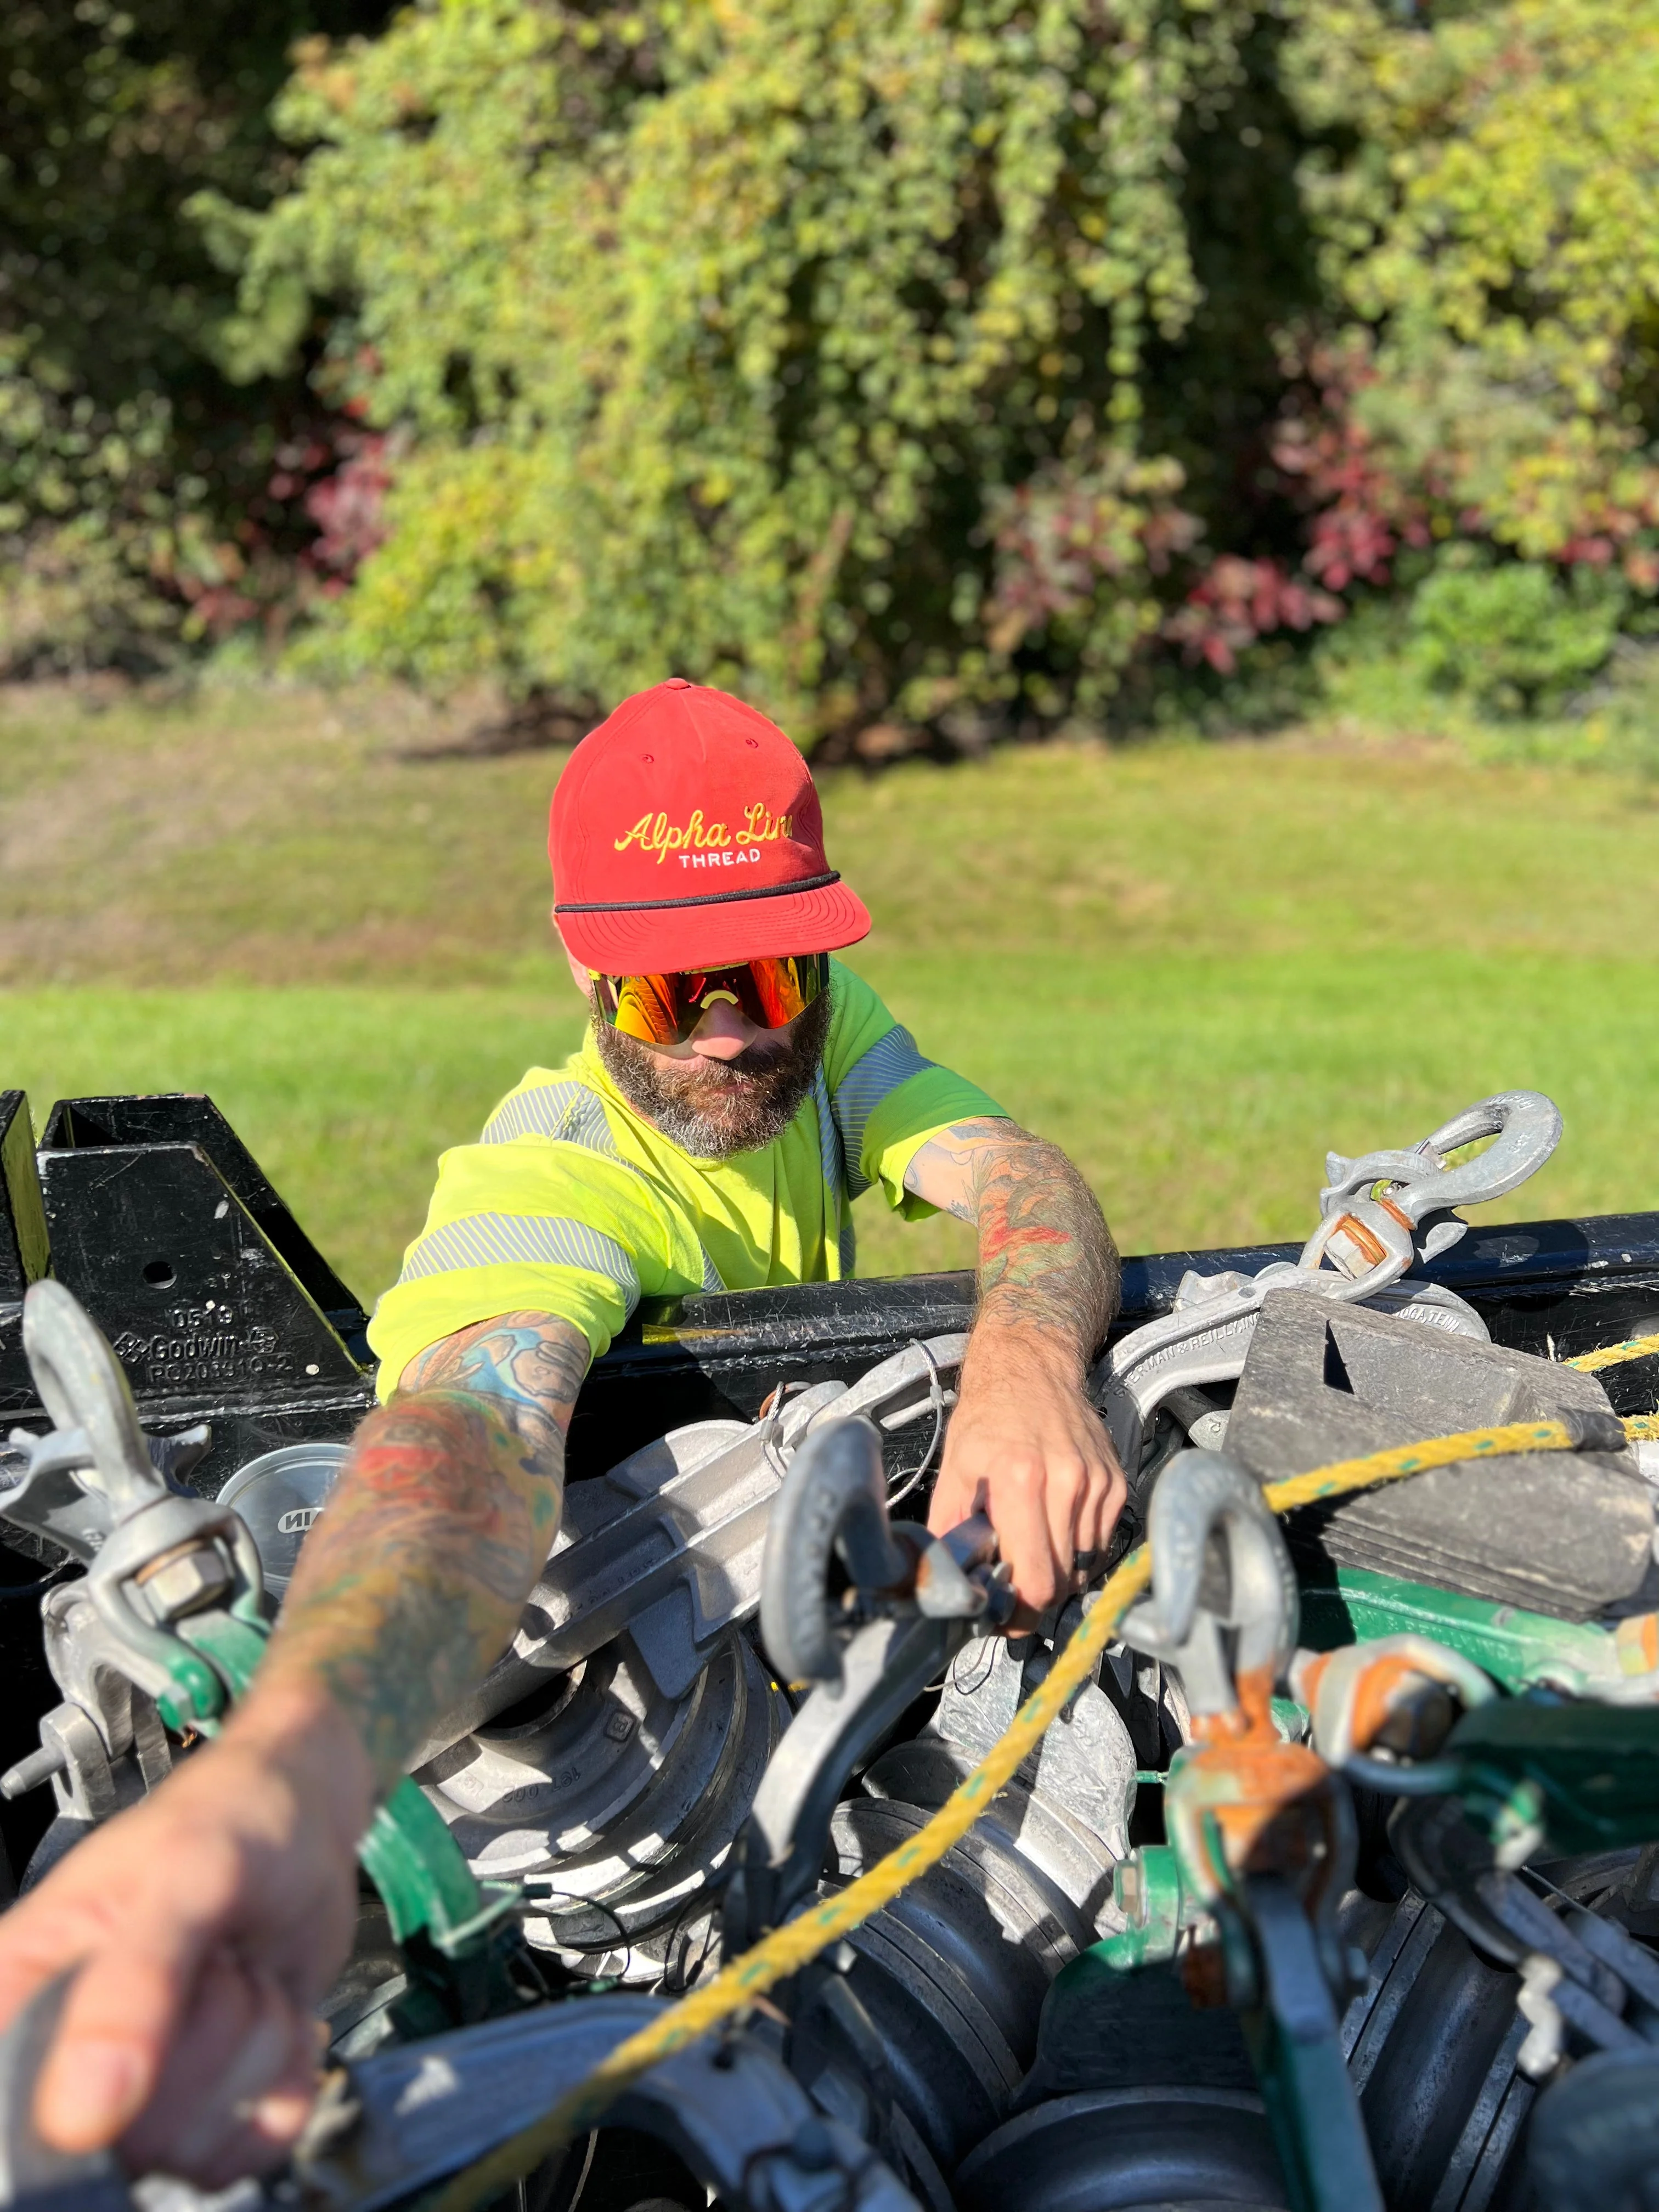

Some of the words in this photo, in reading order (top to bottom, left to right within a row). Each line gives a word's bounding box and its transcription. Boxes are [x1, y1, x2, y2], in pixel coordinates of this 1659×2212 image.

[613, 809, 731, 865] Alpha
[735, 802, 793, 845] Lin
[678, 848, 761, 868] THREAD
[150, 1331, 238, 1362] Godwin
[1113, 1345, 1175, 1398] SHERMAN
[1177, 1341, 1189, 1355] &
